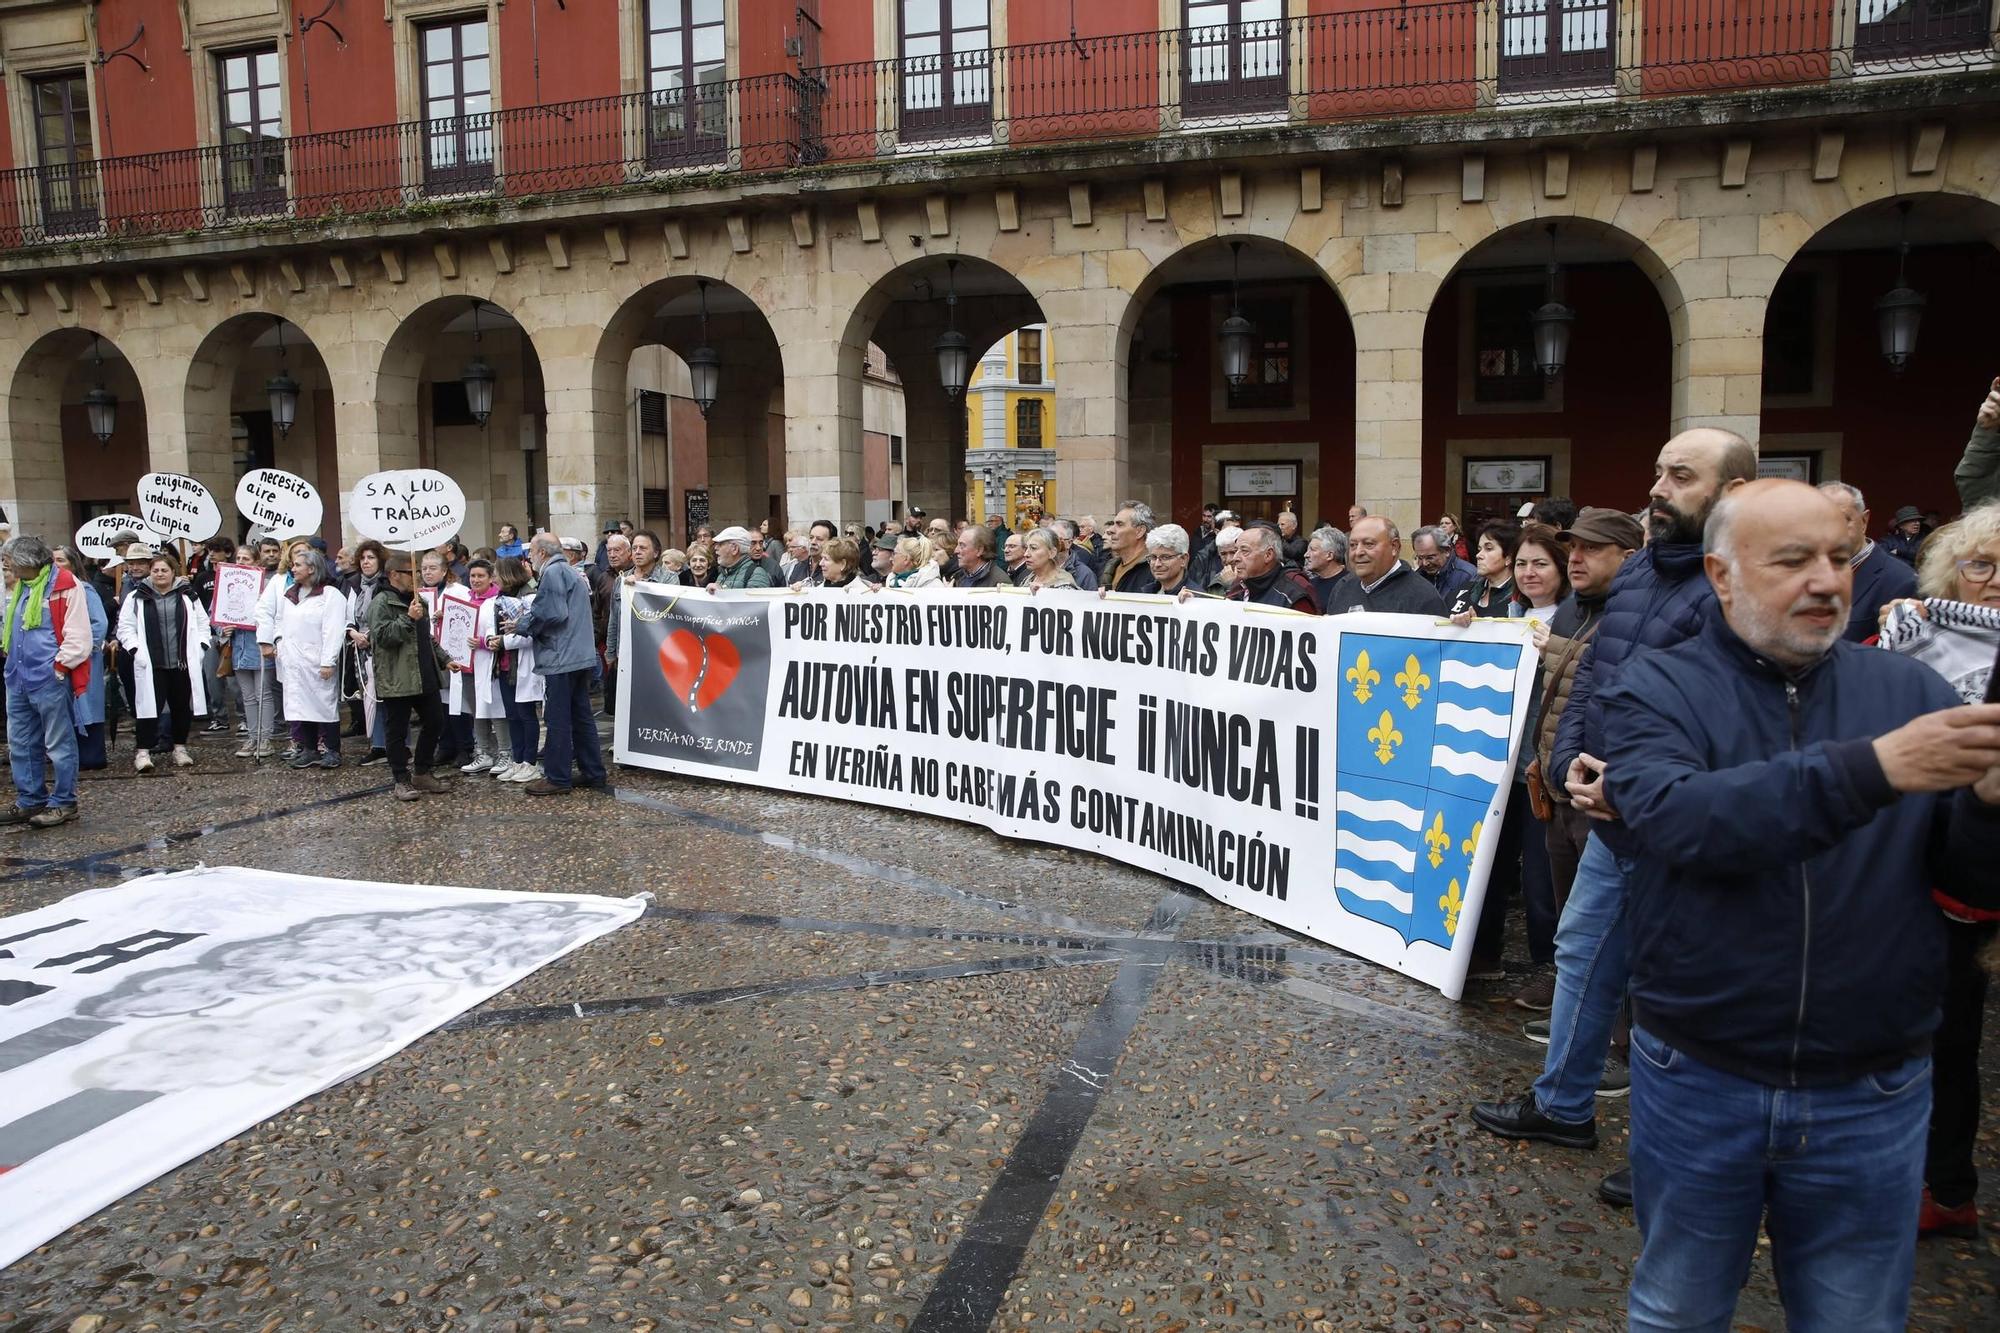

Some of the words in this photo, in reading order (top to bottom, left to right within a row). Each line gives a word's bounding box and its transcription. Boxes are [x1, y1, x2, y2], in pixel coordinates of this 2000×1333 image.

[155, 475, 204, 497] exigimos
[246, 483, 276, 503] aire
[260, 471, 310, 499] necesito
[145, 490, 199, 515] industria
[371, 505, 450, 520] TRABAJO
[401, 494, 415, 510] Y
[98, 516, 144, 531] respiro
[413, 517, 456, 539] ESCLAVITUD
[726, 615, 760, 626] NUNCA
[784, 602, 828, 641] POR
[835, 603, 922, 646] NUESTRO
[927, 604, 1012, 655] FUTURO,
[1020, 606, 1074, 657] POR
[1082, 611, 1220, 677] NUESTRAS
[1228, 624, 1317, 692] VIDAS
[637, 727, 679, 744] VERIÑA
[680, 734, 694, 746] NO
[697, 737, 713, 750] SE
[715, 739, 753, 755] RINDE
[778, 656, 897, 730] AUTOVÍA
[905, 668, 939, 735] EN
[947, 671, 1117, 765] SUPERFICIE
[1164, 698, 1282, 811] NUNCA
[788, 740, 818, 778] EN
[825, 744, 903, 792] VERIÑA
[910, 756, 939, 797] NO
[946, 762, 995, 810] CABE
[996, 770, 1061, 824] MÁS
[1070, 785, 1290, 901] CONTAMINACIÓN
